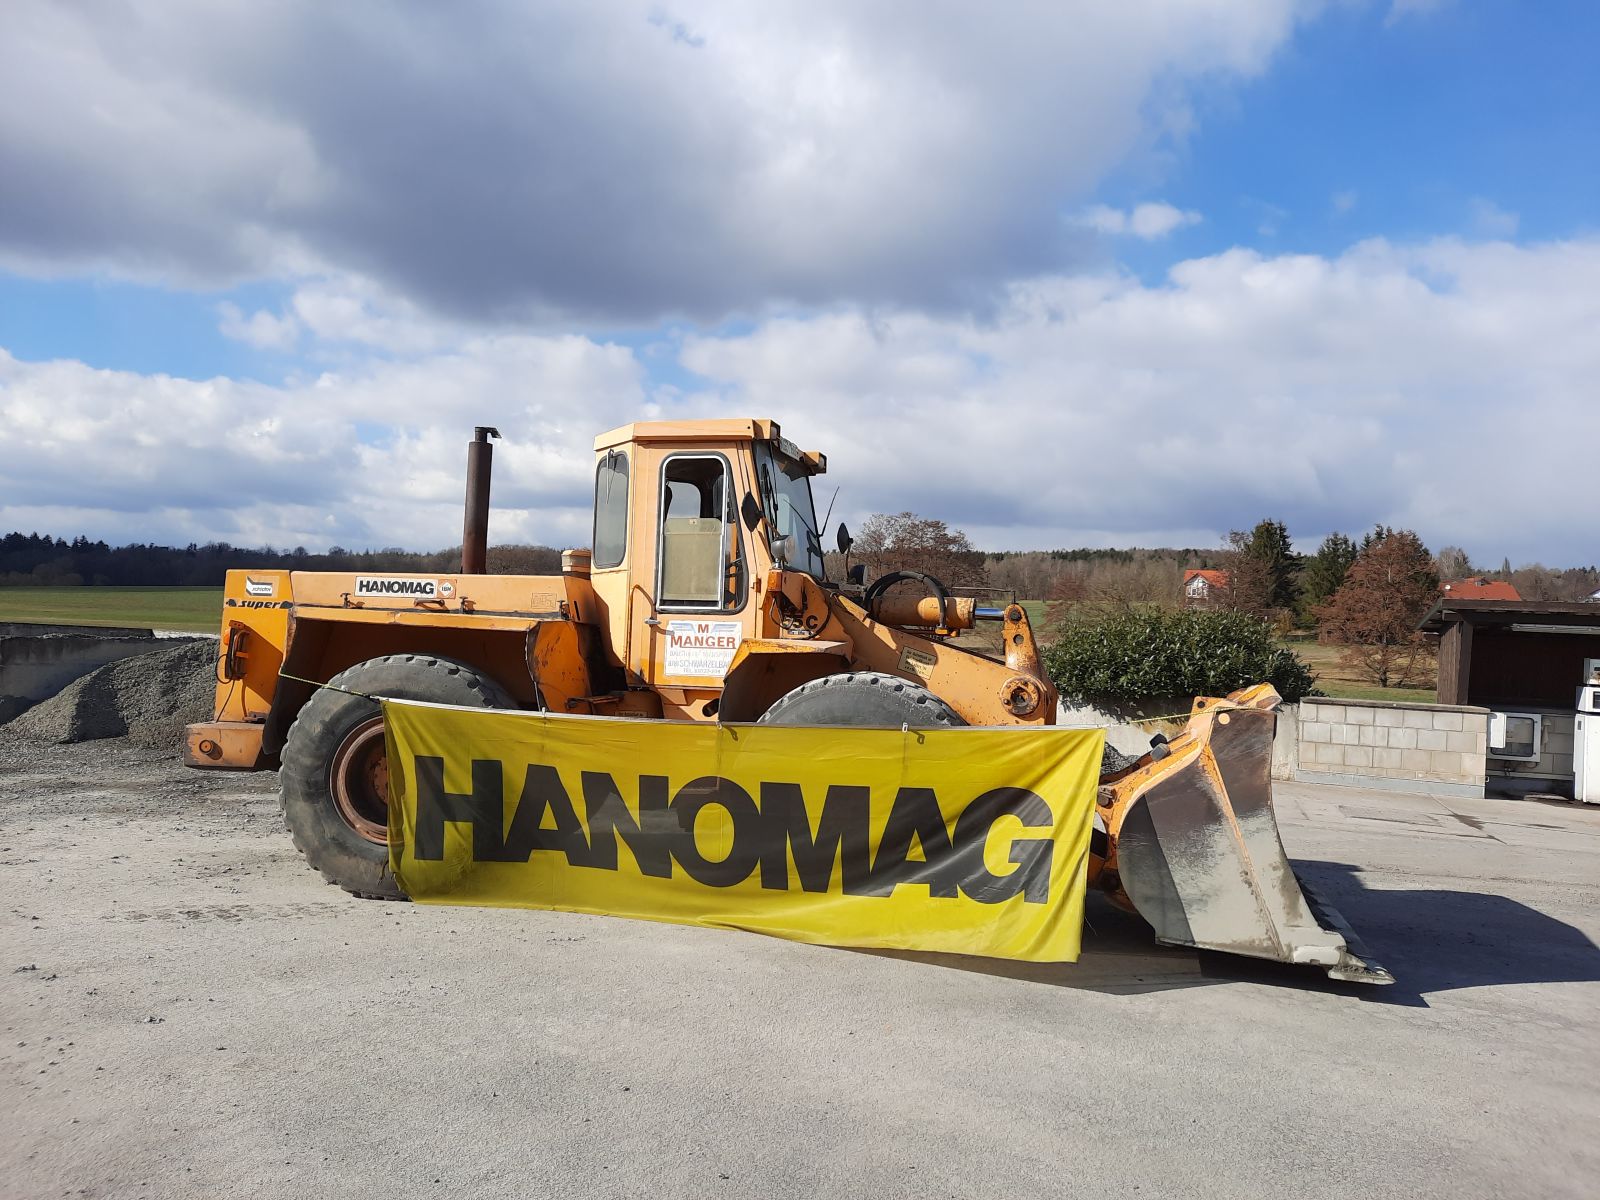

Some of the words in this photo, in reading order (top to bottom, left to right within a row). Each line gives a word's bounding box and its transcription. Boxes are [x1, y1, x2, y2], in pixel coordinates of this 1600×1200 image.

[358, 580, 434, 595] HANOMAG
[238, 600, 280, 609] super
[697, 623, 709, 633] M
[670, 634, 736, 649] MANGER
[413, 755, 1054, 904] HANOMAG
